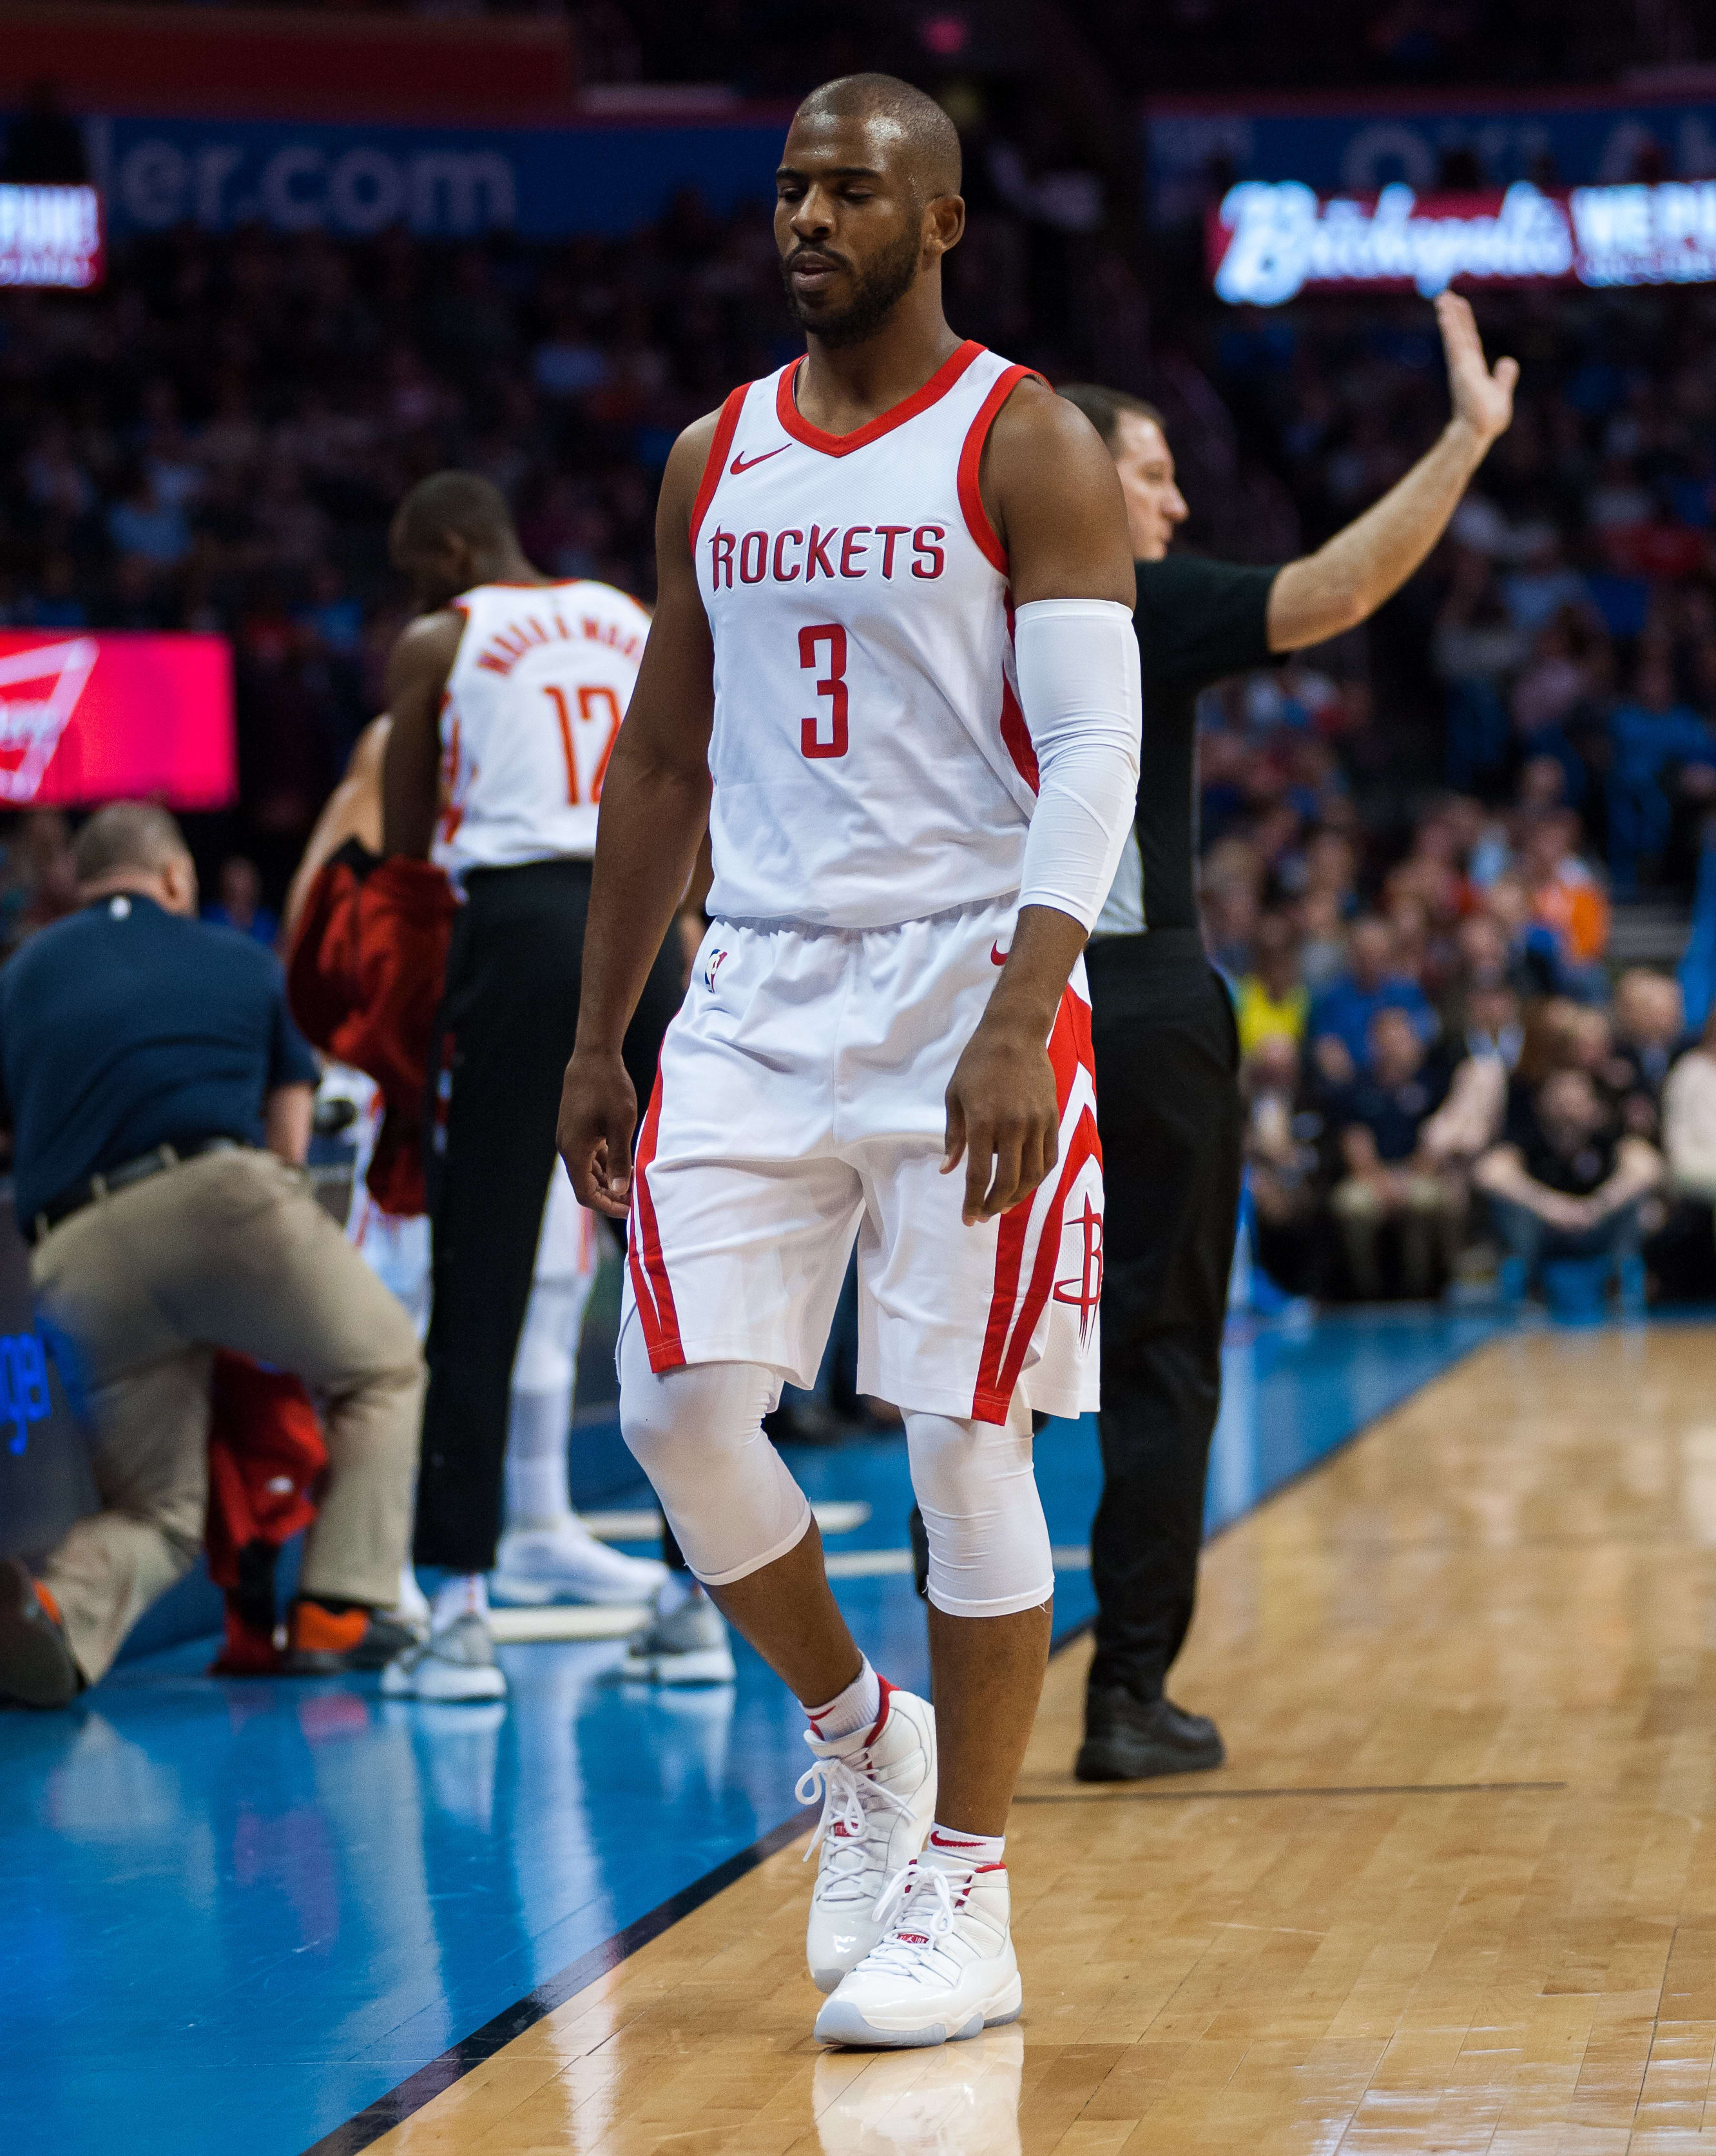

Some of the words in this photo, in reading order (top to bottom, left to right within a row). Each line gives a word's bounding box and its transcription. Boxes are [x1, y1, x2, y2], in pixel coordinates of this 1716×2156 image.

[708, 523, 947, 593] ROCKETS
[543, 686, 622, 806] 12
[798, 623, 849, 759] 3
